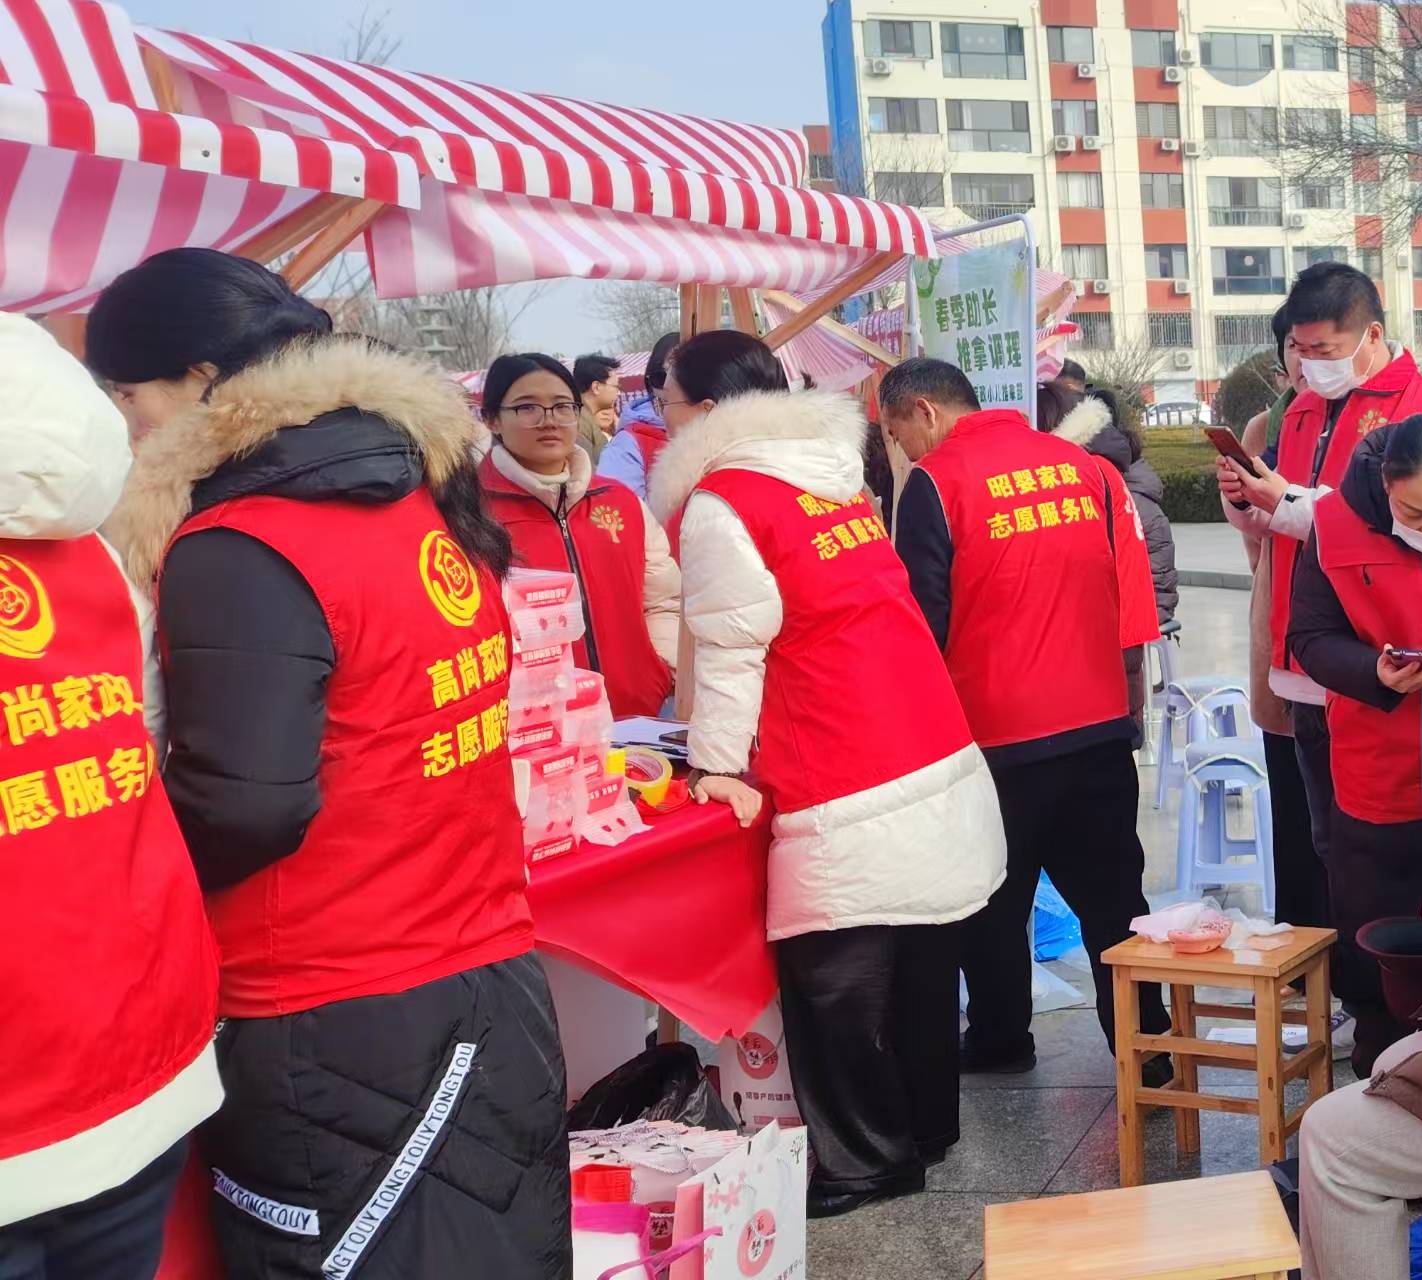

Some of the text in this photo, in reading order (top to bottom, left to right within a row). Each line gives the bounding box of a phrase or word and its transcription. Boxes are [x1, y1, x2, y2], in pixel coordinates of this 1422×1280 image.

[934, 287, 998, 333] 春季助长
[956, 330, 1022, 373] 推拿调理
[986, 463, 1082, 498] 昭婴家政
[986, 496, 1099, 539] 志愿服务队
[0, 740, 155, 836] 愿服务
